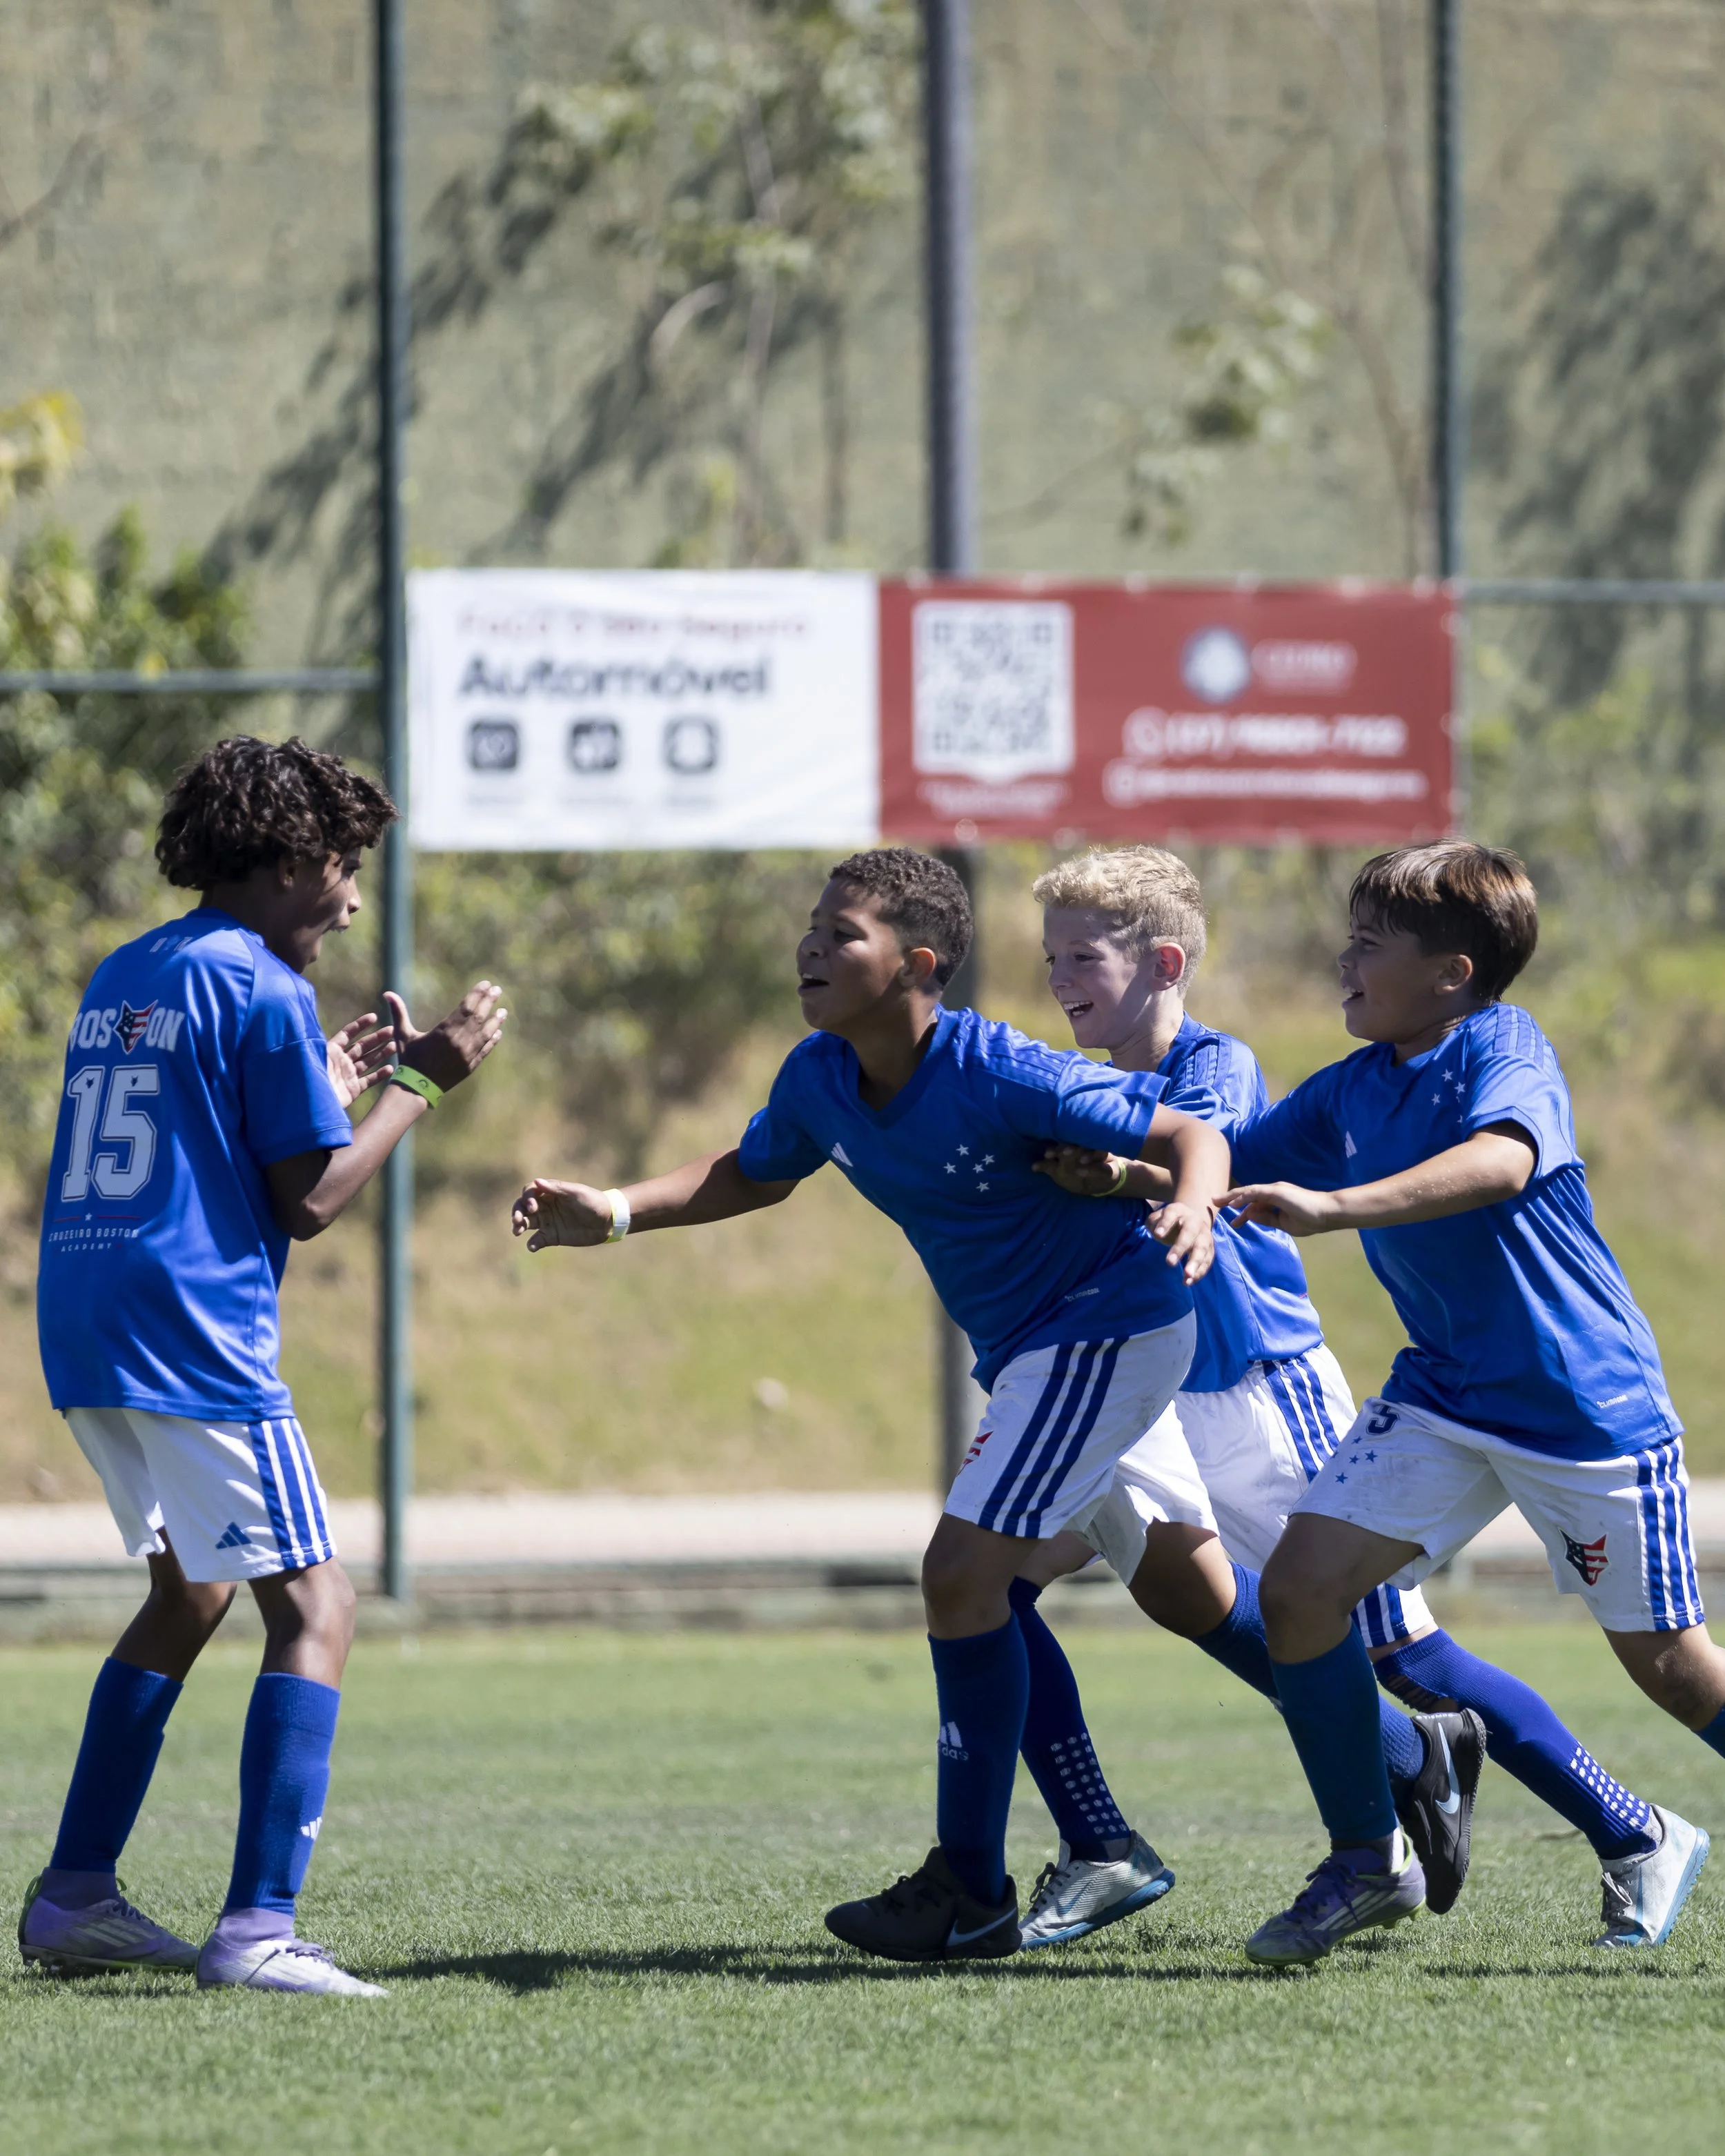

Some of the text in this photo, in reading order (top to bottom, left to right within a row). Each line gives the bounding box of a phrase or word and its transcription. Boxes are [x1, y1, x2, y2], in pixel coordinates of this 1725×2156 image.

[61, 1064, 160, 1203] 15
[48, 1228, 139, 1242] CRUZEIRO BOSTON
[61, 1243, 112, 1252] ACADEMY
